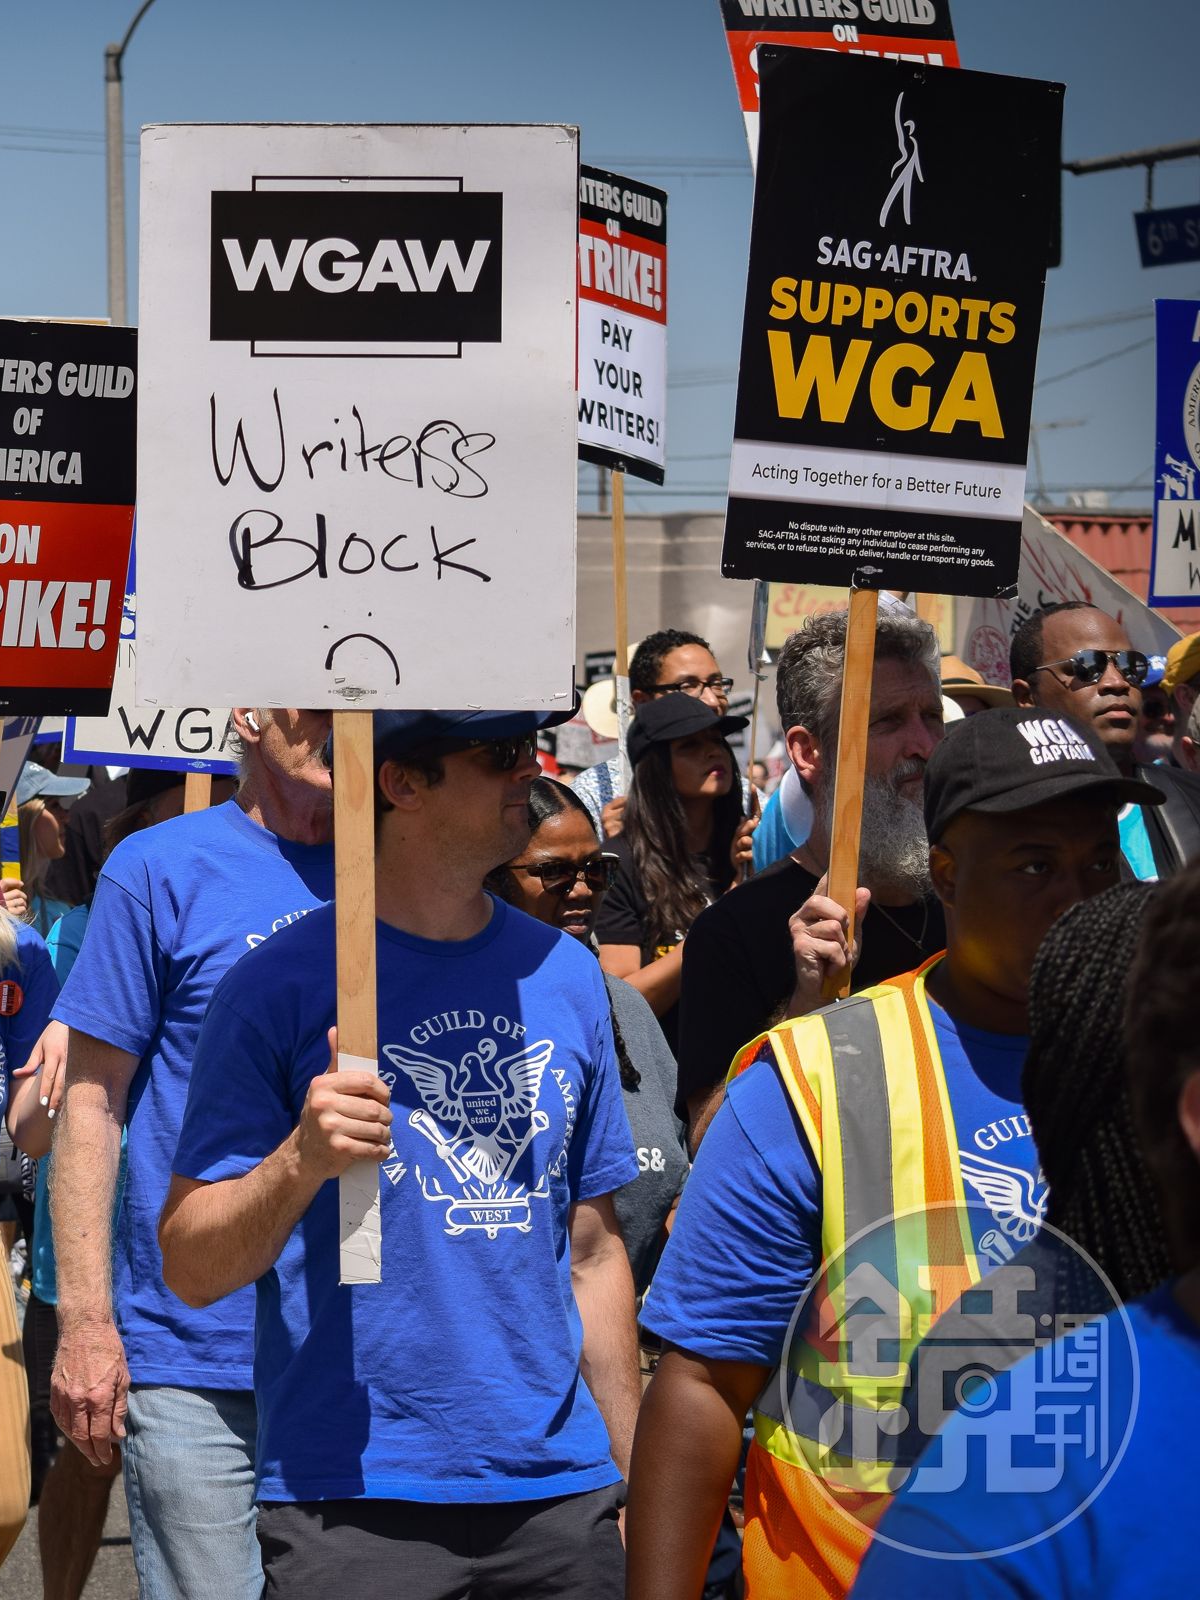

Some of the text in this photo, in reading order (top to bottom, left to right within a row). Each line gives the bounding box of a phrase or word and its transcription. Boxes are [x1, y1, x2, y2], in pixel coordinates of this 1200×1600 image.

[864, 0, 937, 26] GUILD
[833, 24, 859, 42] ON
[580, 176, 662, 227] ITERS GUILD
[606, 217, 620, 238] ON
[1184, 219, 1200, 248] S
[222, 237, 491, 293] WGAW
[578, 233, 662, 312] TRIKE!
[769, 276, 1017, 344] SUPPORTS
[601, 318, 633, 353] PAY
[57, 362, 136, 399] GUILD
[594, 359, 644, 399] YOUR
[767, 330, 1005, 439] WGA
[13, 407, 44, 435] OF
[578, 397, 660, 447] WRITERS!
[752, 463, 1001, 499] Acting Together for a Better Future
[229, 509, 491, 590] Block
[758, 529, 985, 557] SAG-AFTRA is not asking any individual to cease performing any
[788, 521, 956, 543] No dispute with any other employer at this site.
[746, 540, 777, 551] services,
[787, 543, 794, 551] to
[796, 544, 818, 553] refuse
[828, 546, 844, 556] pick
[846, 548, 857, 557] up,
[859, 549, 885, 559] deliver,
[887, 551, 911, 561] handle
[912, 553, 920, 561] or
[921, 554, 955, 565] transport
[956, 558, 970, 566] any
[971, 558, 995, 567] goods.
[1009, 599, 1032, 638] THE
[1017, 719, 1085, 747] WGA
[1029, 744, 1095, 765] CAPTAIN
[410, 1010, 527, 1045] GUILD OF
[466, 1097, 497, 1108] united
[470, 1113, 497, 1124] stand
[550, 1068, 578, 1178] AMERICA
[470, 1208, 511, 1222] WEST
